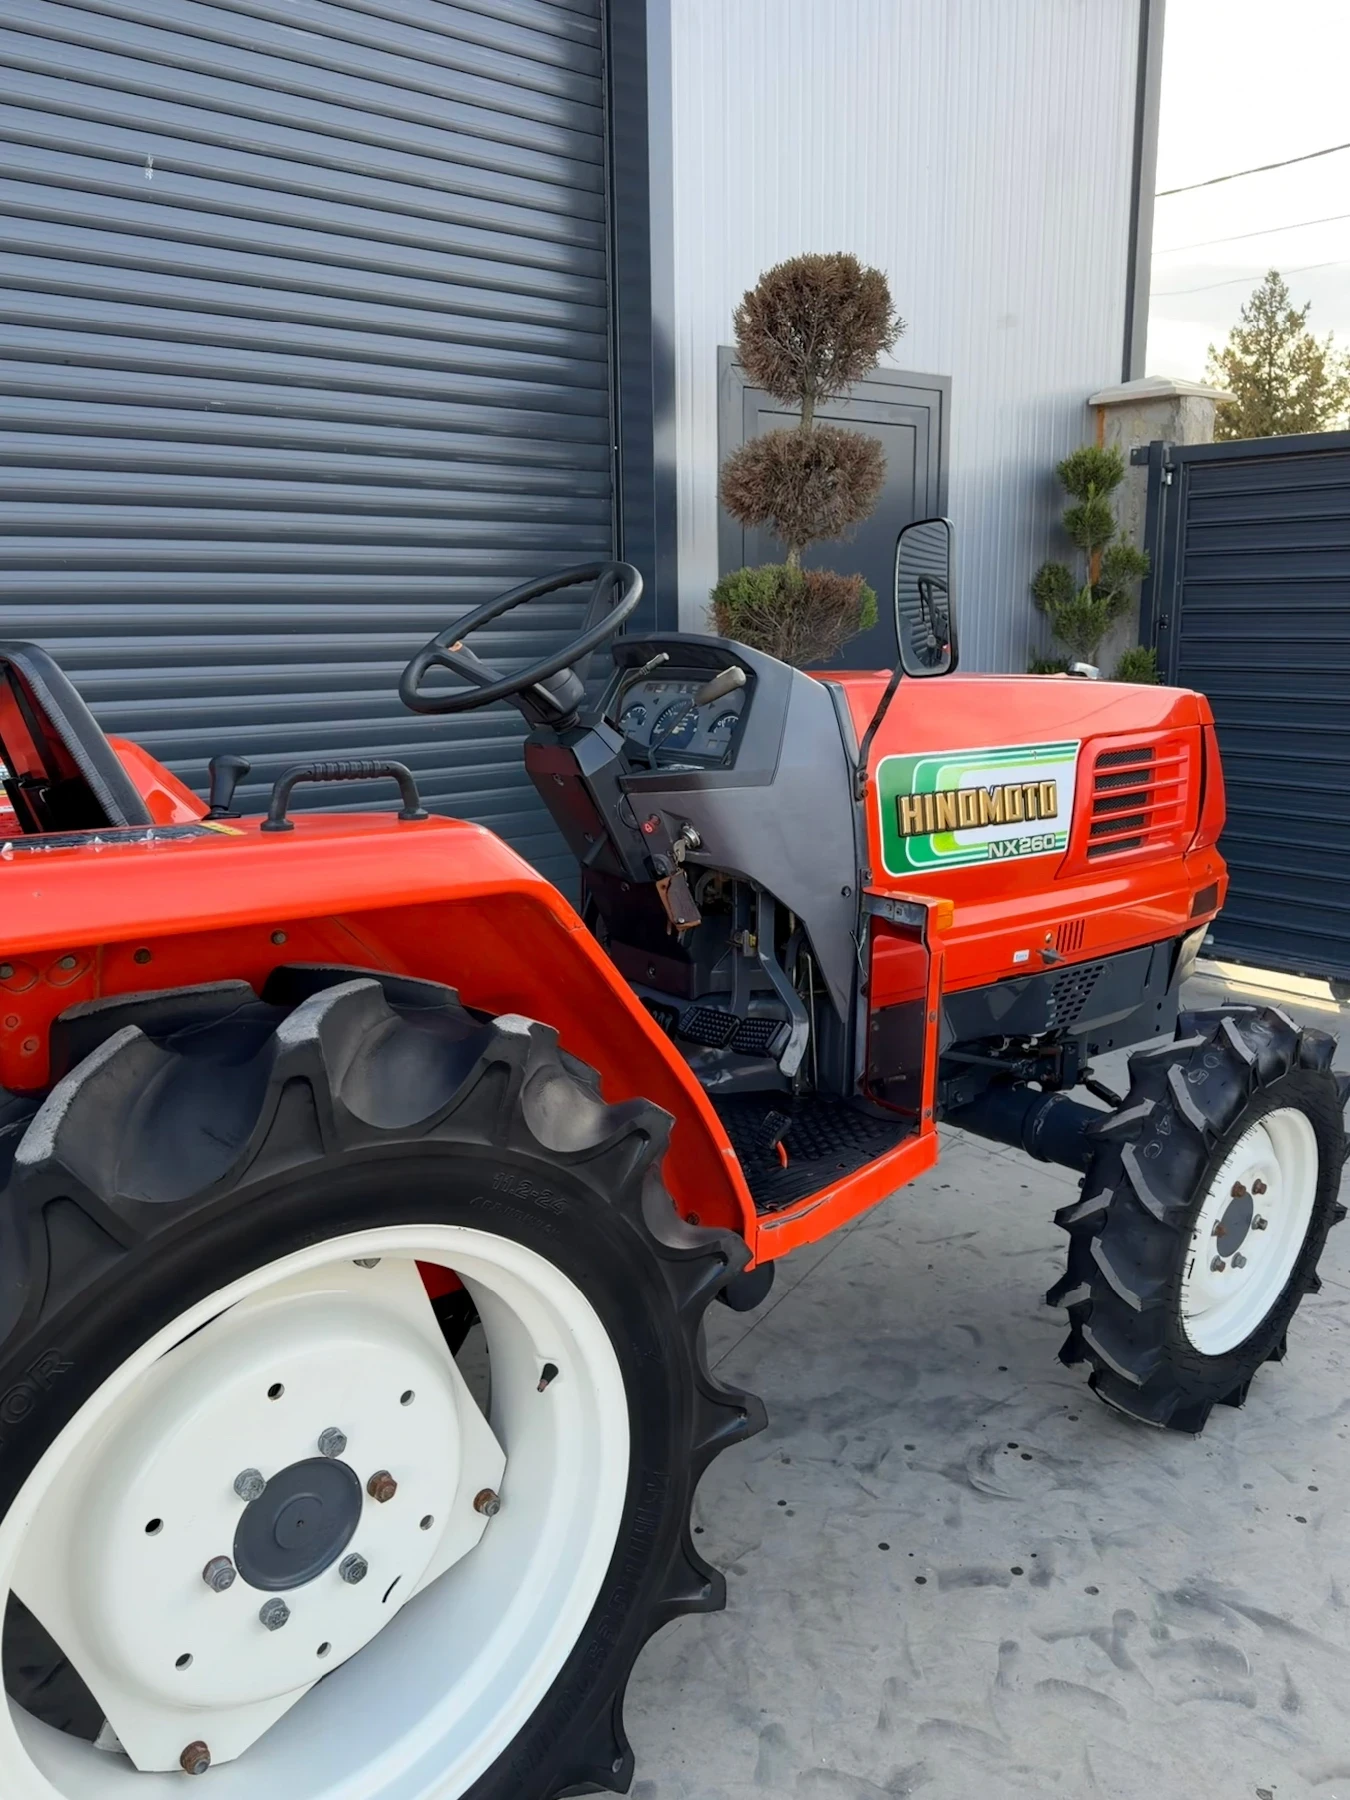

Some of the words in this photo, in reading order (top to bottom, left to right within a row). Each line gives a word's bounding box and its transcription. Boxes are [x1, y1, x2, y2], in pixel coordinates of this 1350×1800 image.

[898, 780, 1057, 836] HINOMOTO
[987, 833, 1056, 859] NX260
[491, 1171, 567, 1216] 11.2-24
